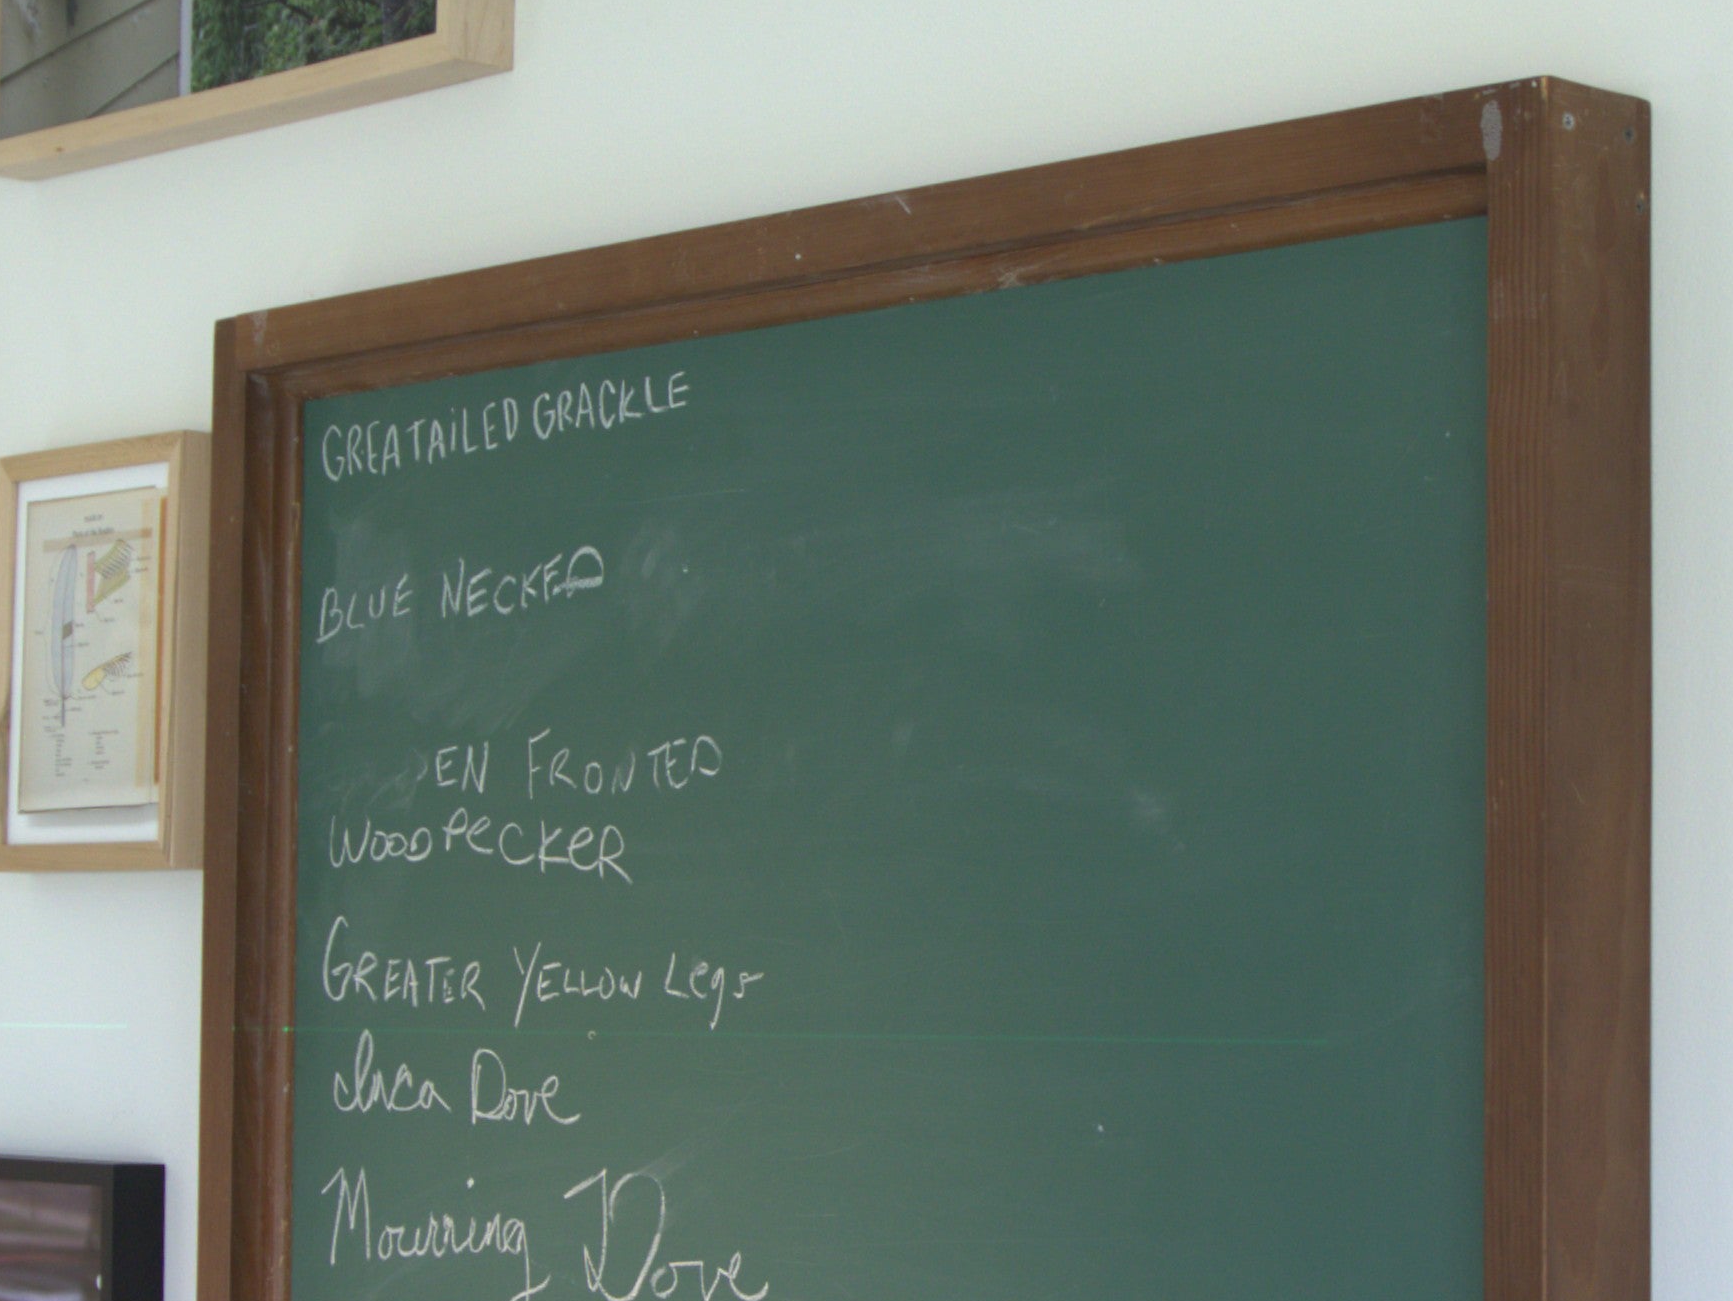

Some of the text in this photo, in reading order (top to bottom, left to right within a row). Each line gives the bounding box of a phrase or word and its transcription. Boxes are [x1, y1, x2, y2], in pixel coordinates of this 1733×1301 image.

[532, 370, 691, 440] GRACKLE
[316, 545, 604, 643] BLUE NECKED
[528, 728, 722, 800] FRONTED
[513, 941, 642, 1028] YELLOW
[471, 1047, 581, 1125] Dove
